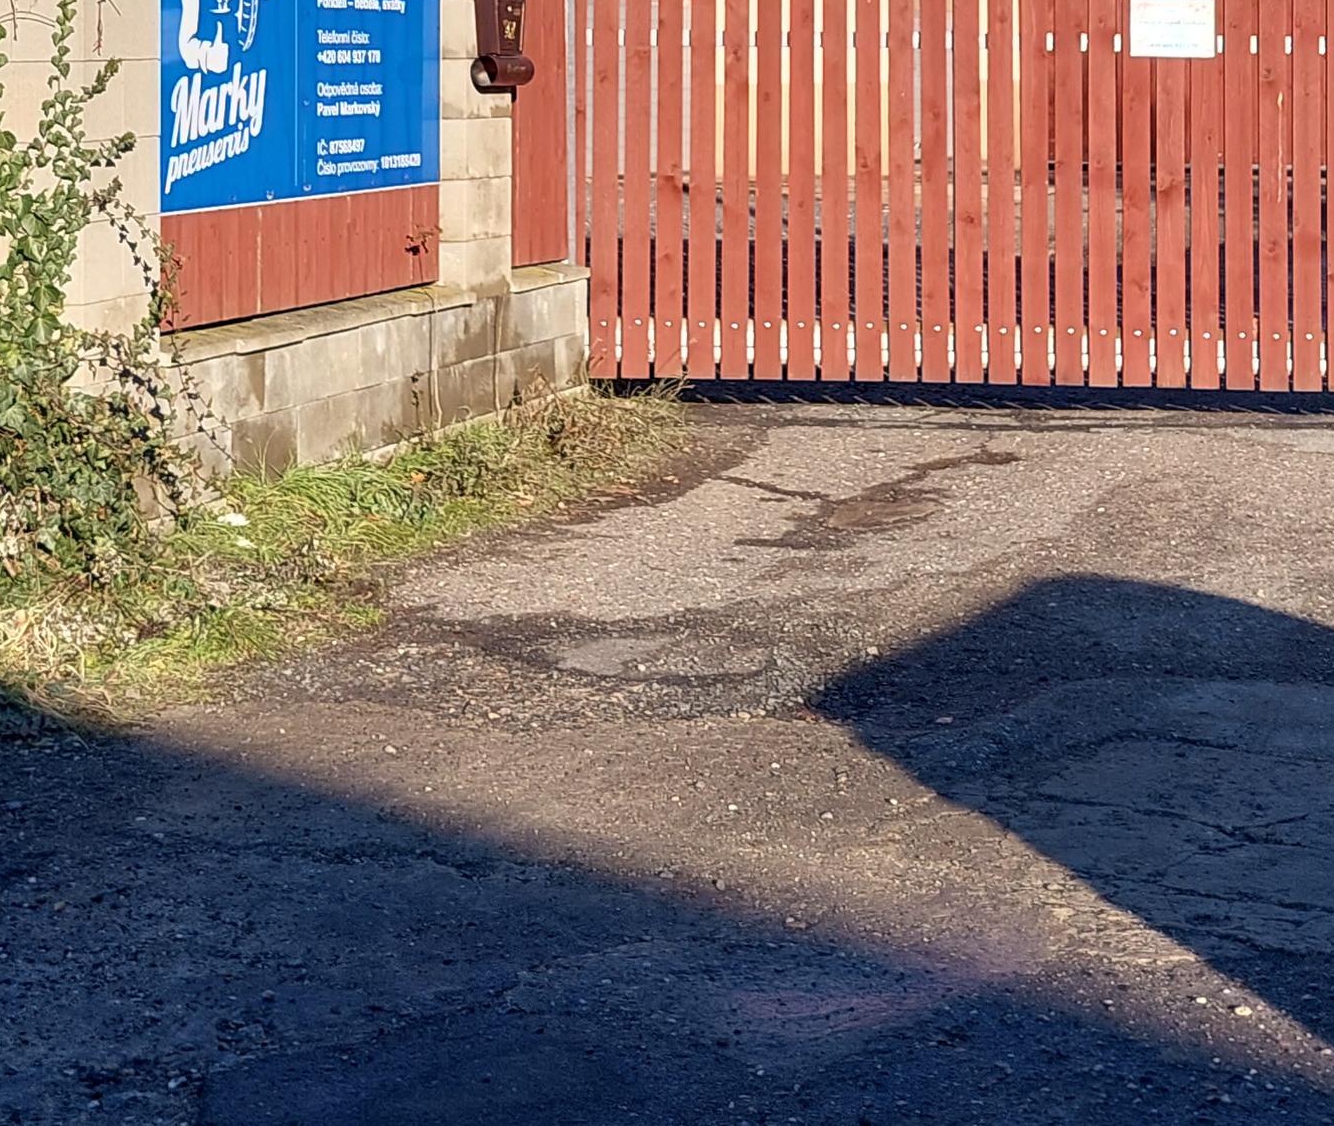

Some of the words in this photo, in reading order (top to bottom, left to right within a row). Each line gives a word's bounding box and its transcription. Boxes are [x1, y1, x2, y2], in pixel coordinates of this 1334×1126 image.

[317, 29, 350, 44] Telefonní
[351, 30, 370, 44] číslo:
[317, 50, 336, 64] +420
[337, 50, 351, 64] 604
[352, 50, 366, 64] 937
[317, 82, 358, 98] Odpovědná
[360, 82, 383, 96] osoba:
[171, 61, 267, 149] Marky
[317, 102, 338, 116] Pavel
[340, 101, 381, 117] Markovský
[164, 122, 249, 195] pneuservis
[317, 159, 337, 176] Číslo
[337, 159, 380, 177] provozovny:
